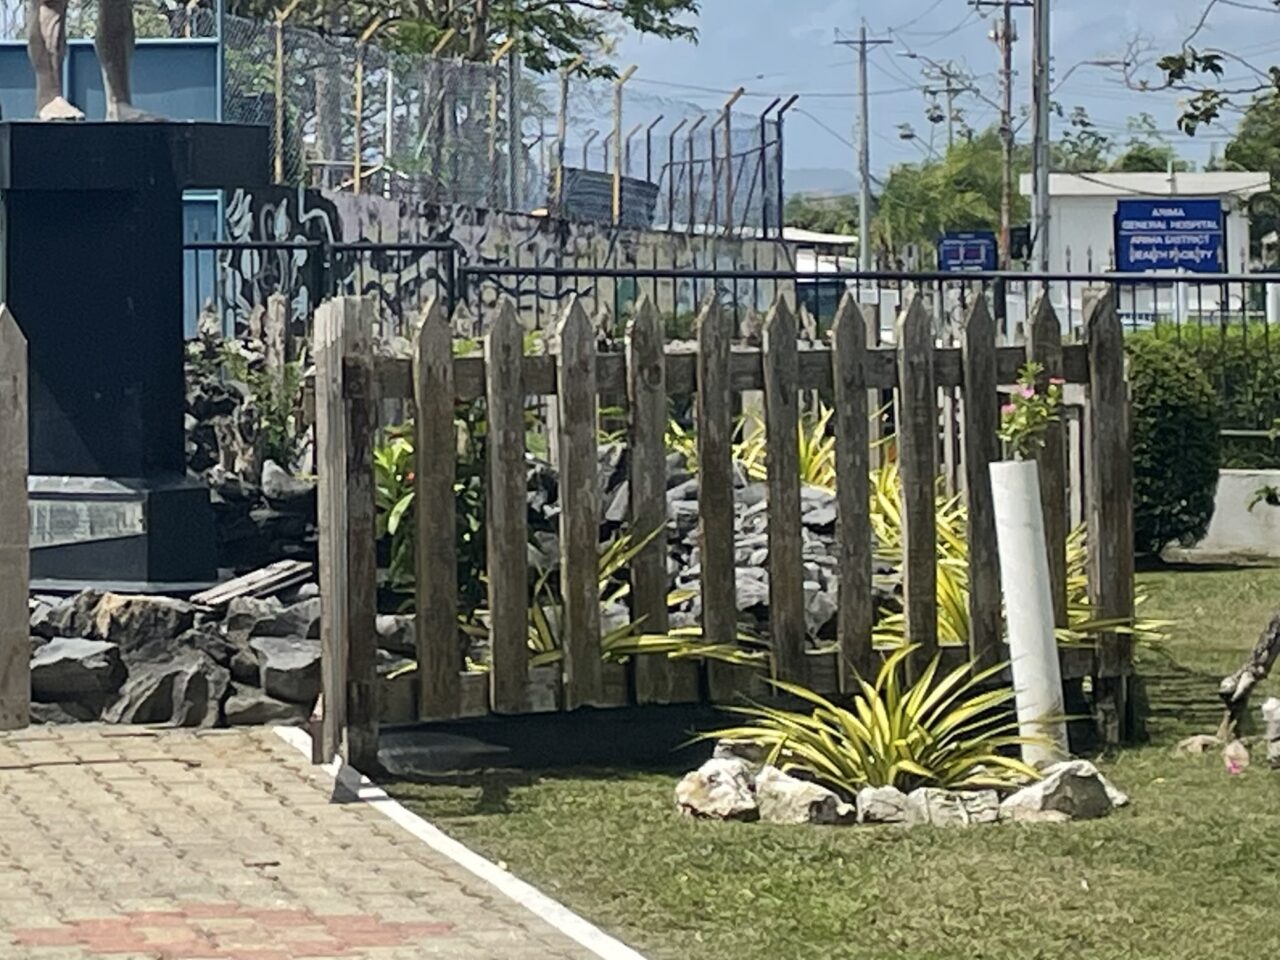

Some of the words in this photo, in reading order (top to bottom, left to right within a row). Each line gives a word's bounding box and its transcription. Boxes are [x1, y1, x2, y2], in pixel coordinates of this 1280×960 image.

[1151, 207, 1186, 217] ARIMA
[1121, 220, 1167, 230] GENERAL
[1170, 220, 1219, 230] HOSPITAL
[1130, 235, 1163, 244] ARIMA
[1165, 234, 1210, 245] DISTRICT
